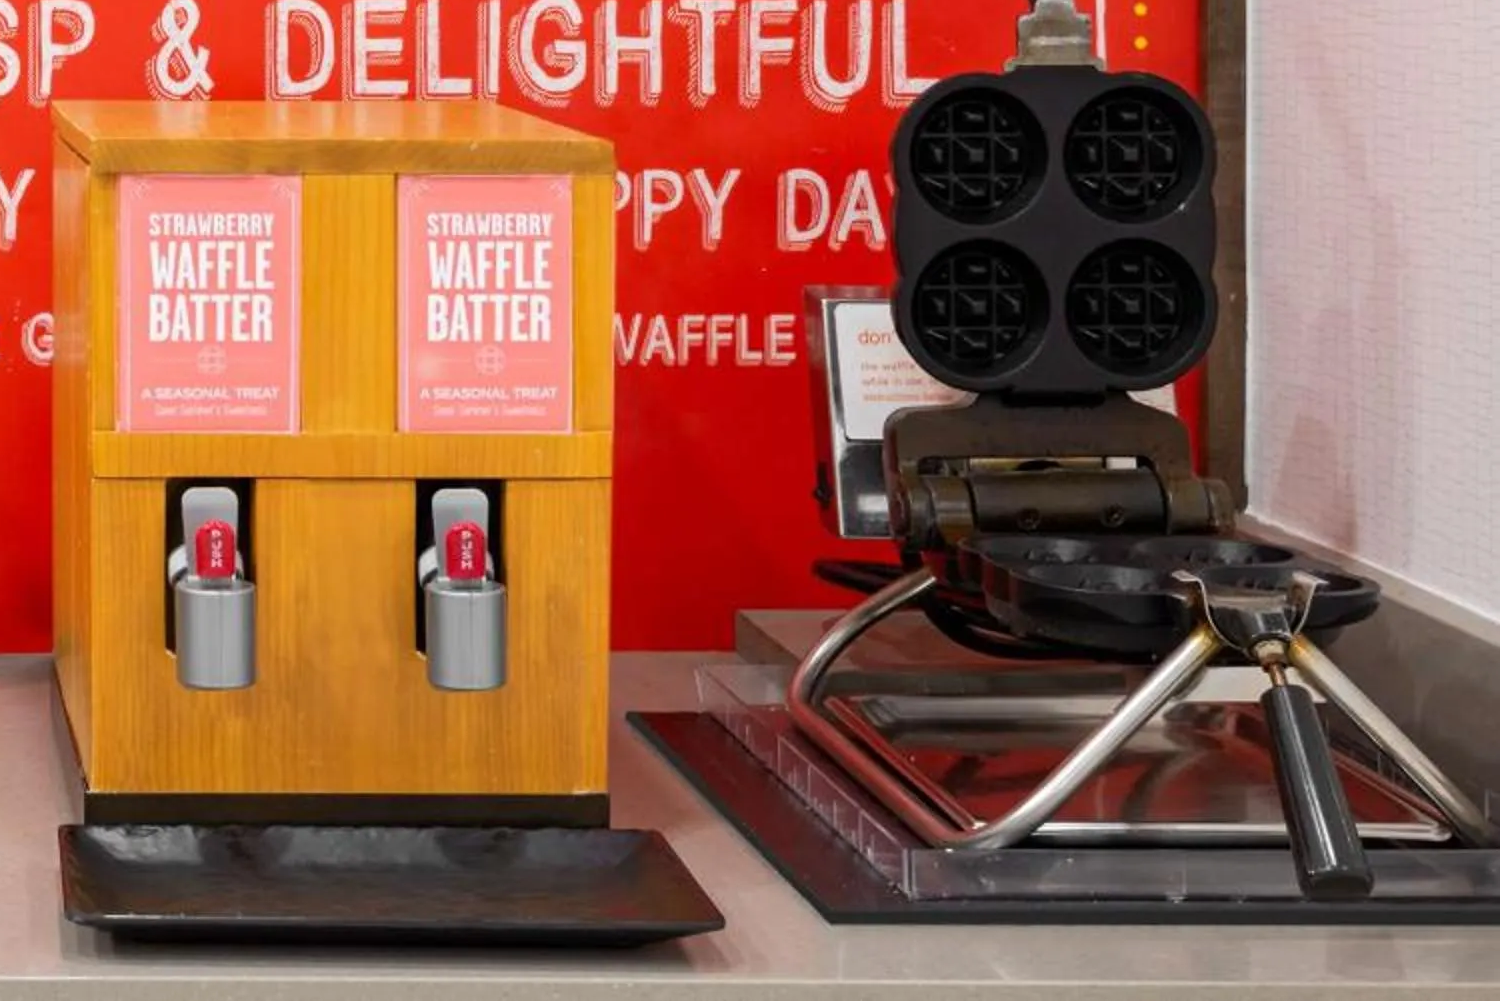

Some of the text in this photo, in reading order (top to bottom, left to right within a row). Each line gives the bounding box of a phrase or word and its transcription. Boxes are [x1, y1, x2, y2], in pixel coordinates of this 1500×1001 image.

[149, 212, 274, 236] STRAWBERRY
[427, 212, 553, 236] STRAWBERRY
[778, 168, 895, 251] DA
[149, 240, 274, 289] WAFFLE
[427, 240, 552, 289] WAFFLE
[149, 293, 273, 342] BATTER
[427, 293, 551, 342] BATTER
[140, 386, 280, 399] A SEASONAL TREAT
[420, 386, 557, 399] A SEASONAL TREAT
[211, 529, 223, 568] PUSH
[461, 530, 473, 570] PUSH
